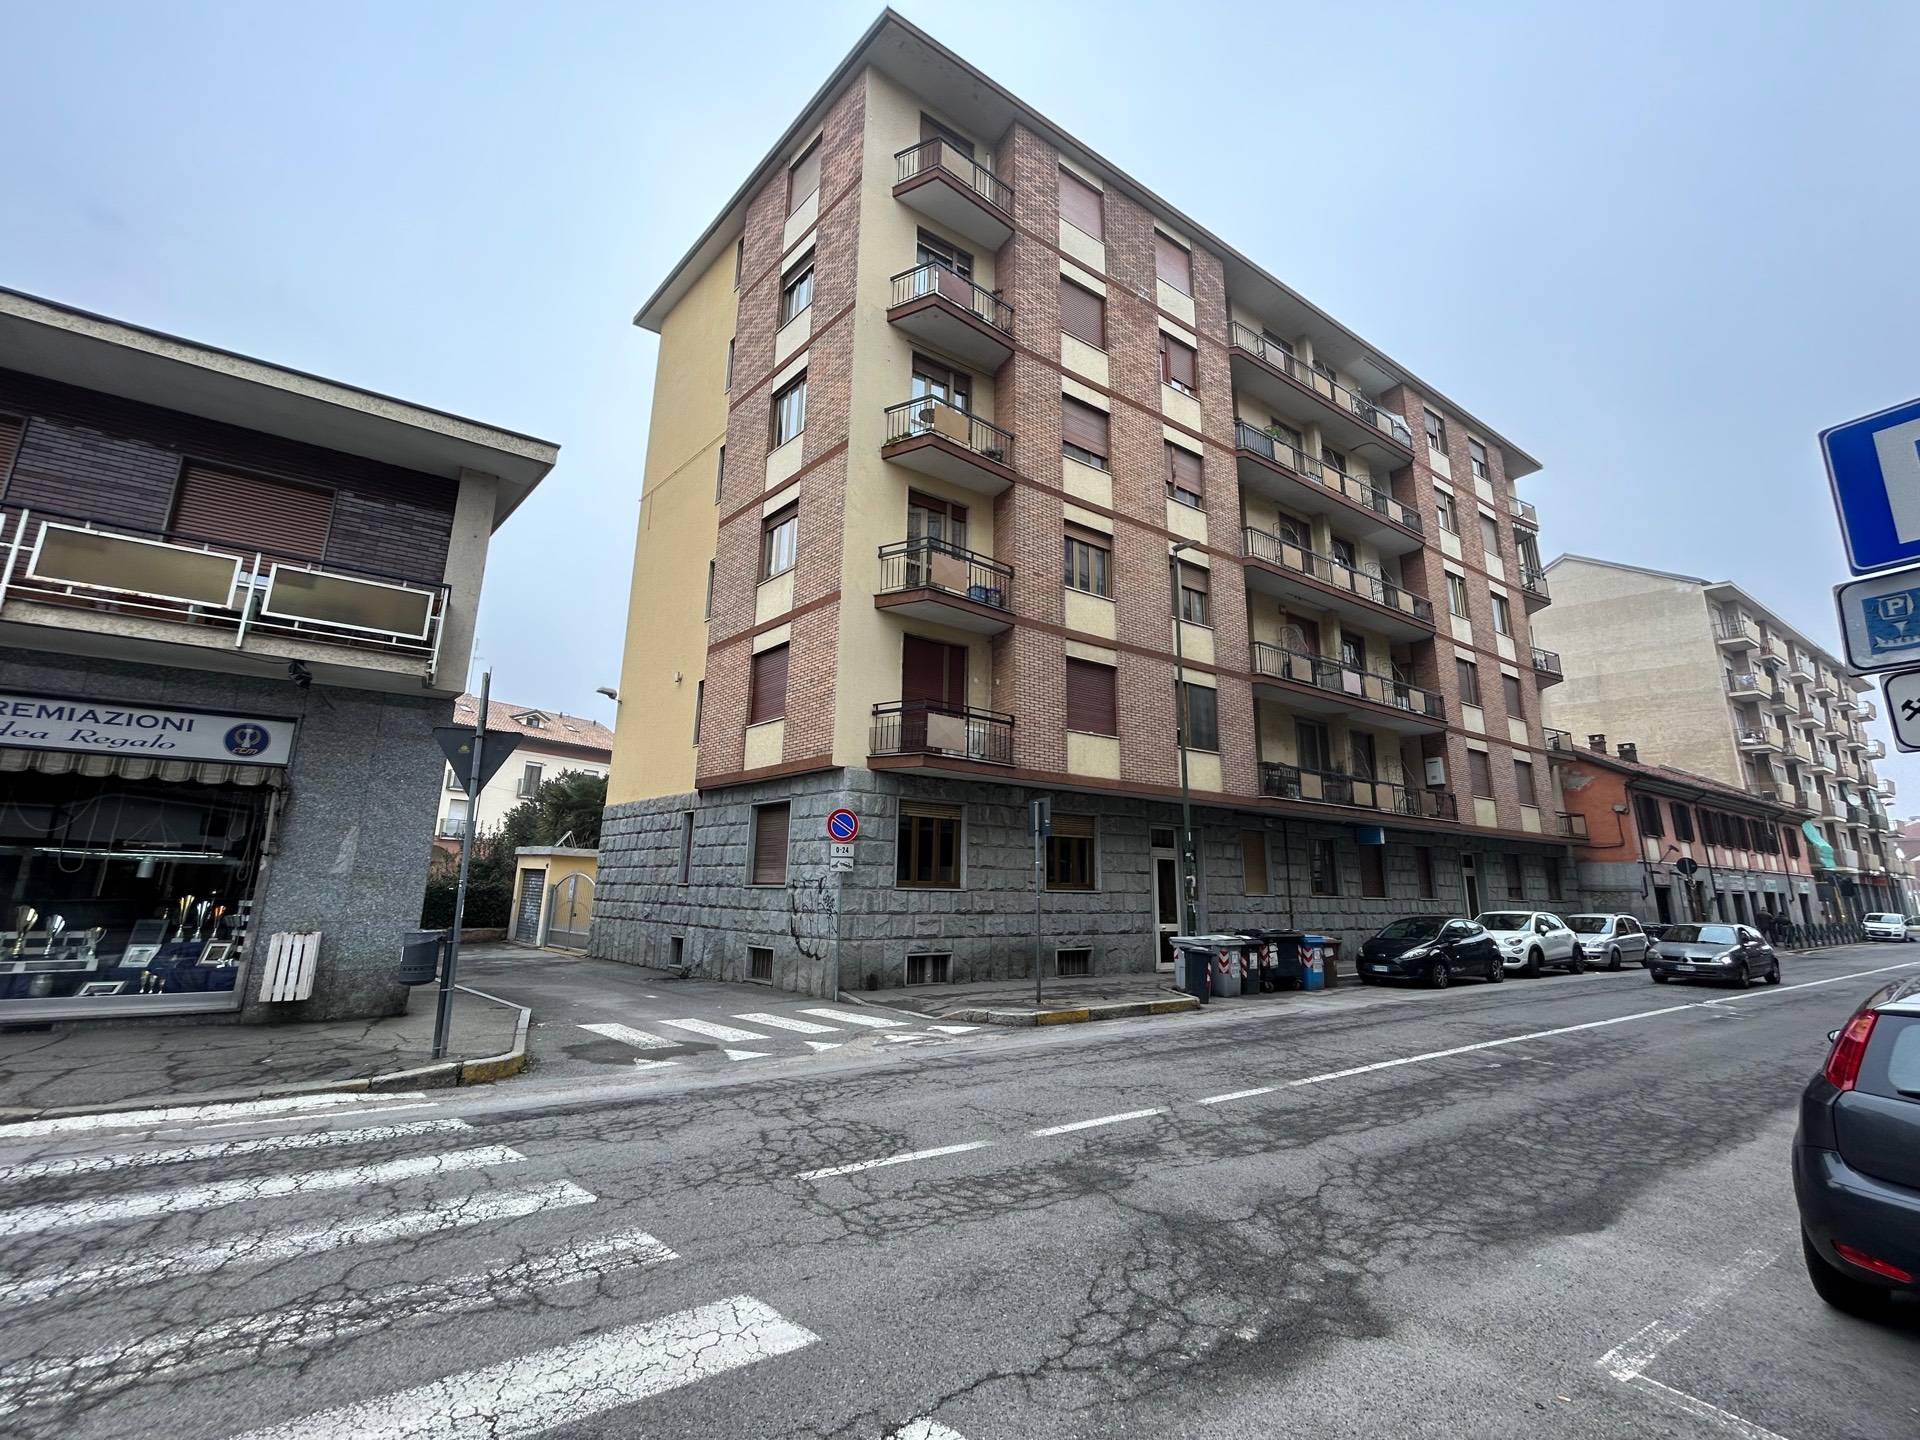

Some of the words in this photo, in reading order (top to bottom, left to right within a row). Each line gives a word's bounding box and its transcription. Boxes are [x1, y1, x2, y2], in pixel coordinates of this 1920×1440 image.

[1887, 597, 1904, 616] P
[65, 728, 176, 749] Regalo
[836, 846, 849, 854] 0-24
